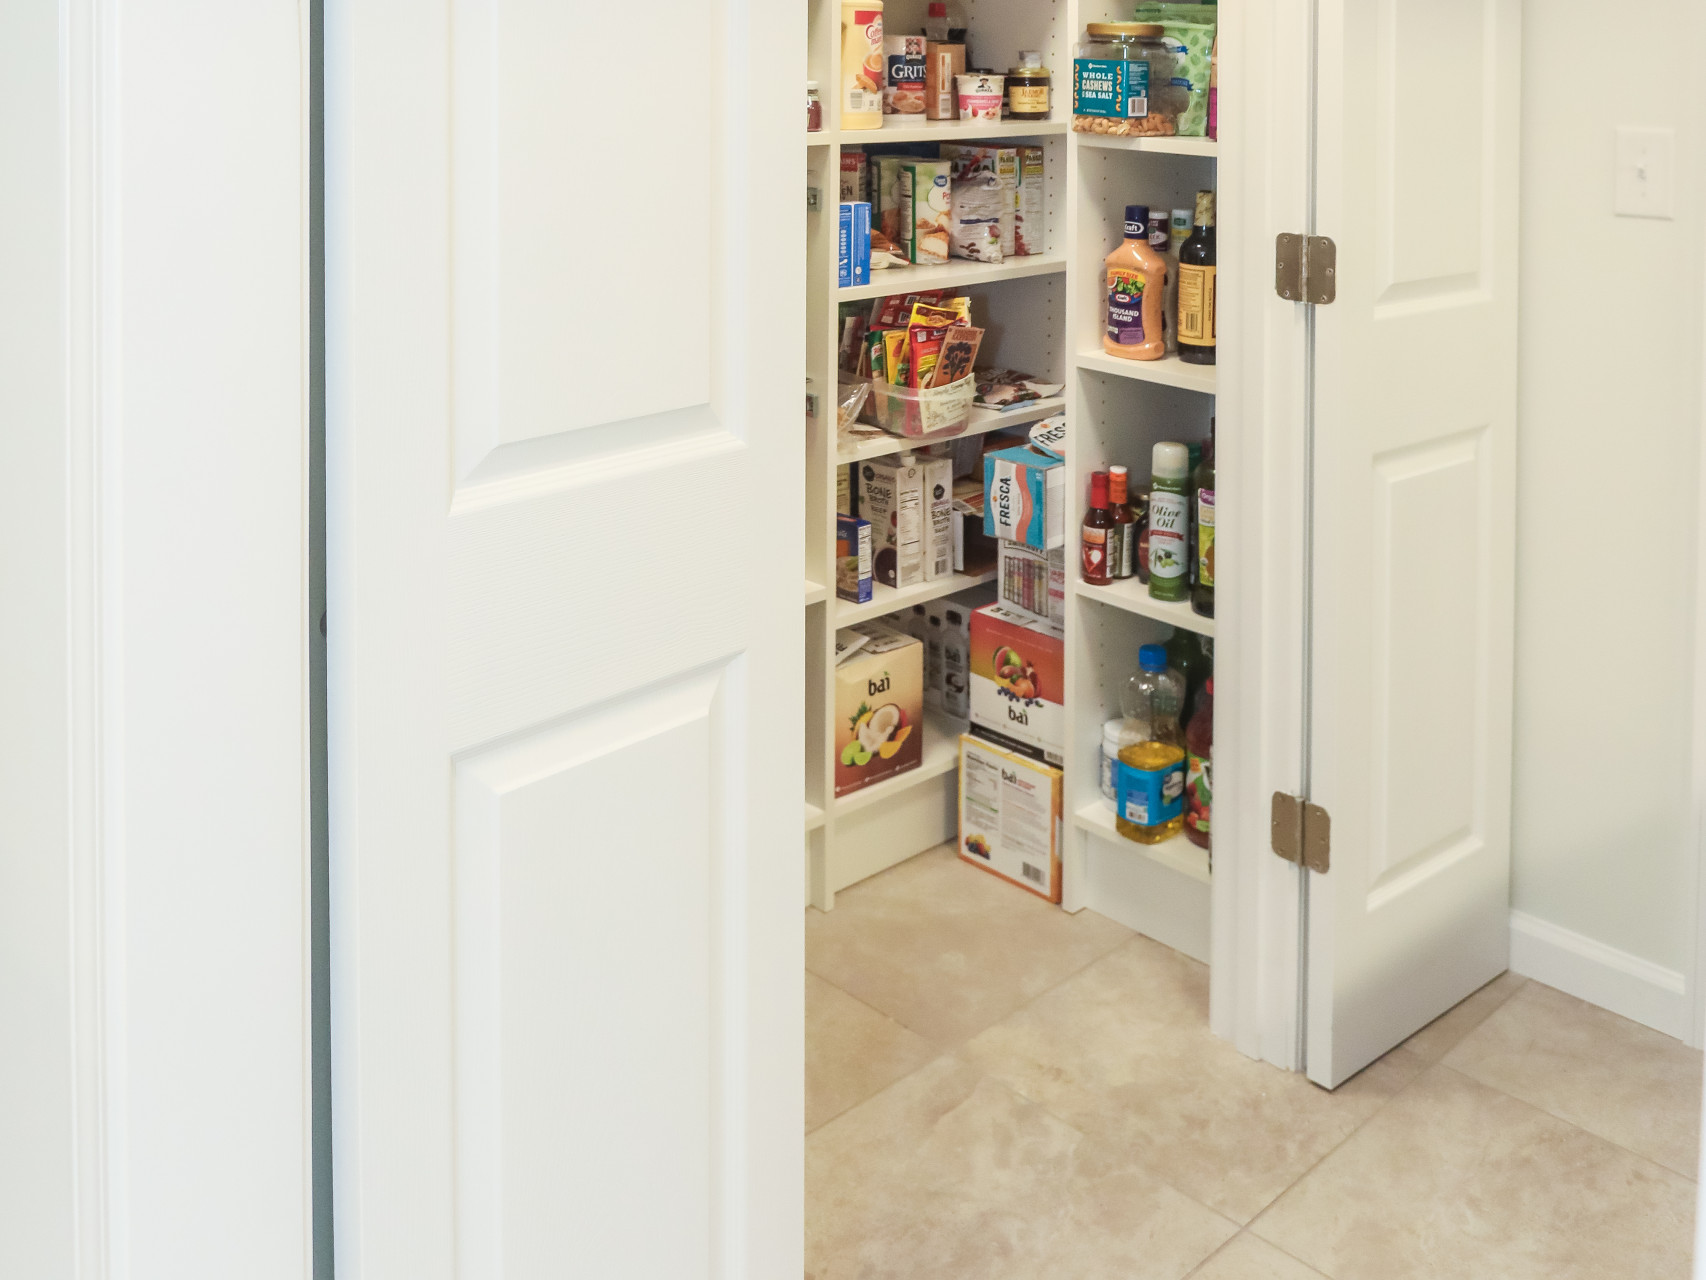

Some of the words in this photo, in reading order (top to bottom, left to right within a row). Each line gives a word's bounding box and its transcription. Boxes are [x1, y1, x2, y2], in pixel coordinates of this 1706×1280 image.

[1082, 71, 1113, 80] WHOLE
[1081, 79, 1113, 92] CASHEWS
[1085, 91, 1097, 99] SEA
[1097, 91, 1114, 100] SALT
[1109, 306, 1140, 317] THOUSAND
[1112, 313, 1133, 323] ISLAND
[865, 483, 892, 499] BONE
[999, 475, 1012, 527] FRESCA
[931, 507, 951, 520] BONE
[1152, 504, 1181, 518] Olive
[1156, 517, 1176, 529] Oil
[868, 671, 891, 697] bai
[1008, 705, 1029, 727] bai
[1002, 767, 1018, 785] bai
